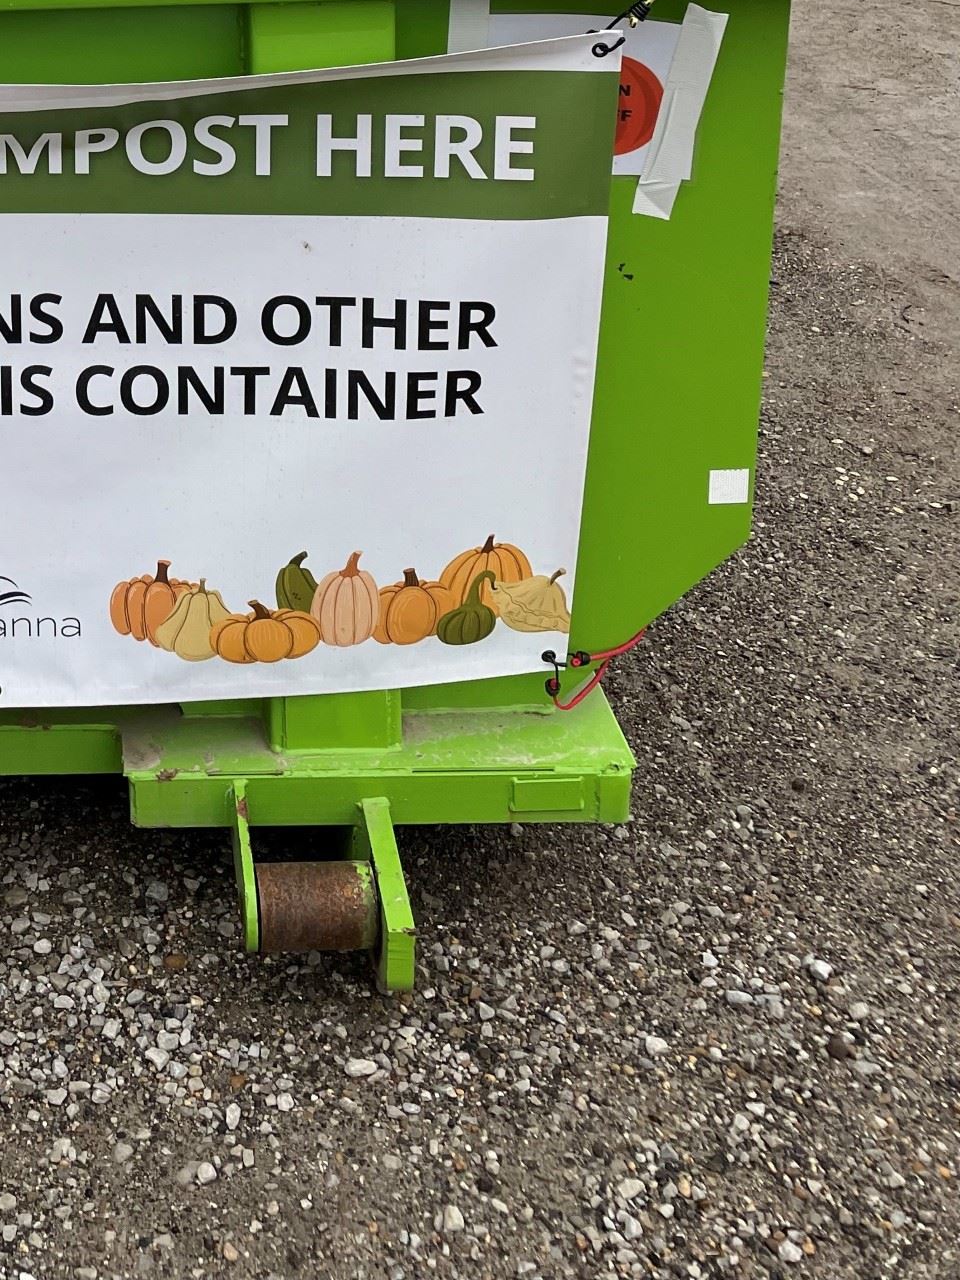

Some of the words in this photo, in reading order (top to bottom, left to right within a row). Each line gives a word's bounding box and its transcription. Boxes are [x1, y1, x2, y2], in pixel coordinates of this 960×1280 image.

[315, 113, 538, 182] HERE
[81, 293, 238, 346] AND
[260, 295, 499, 352] OTHER
[74, 364, 485, 422] CONTAINER
